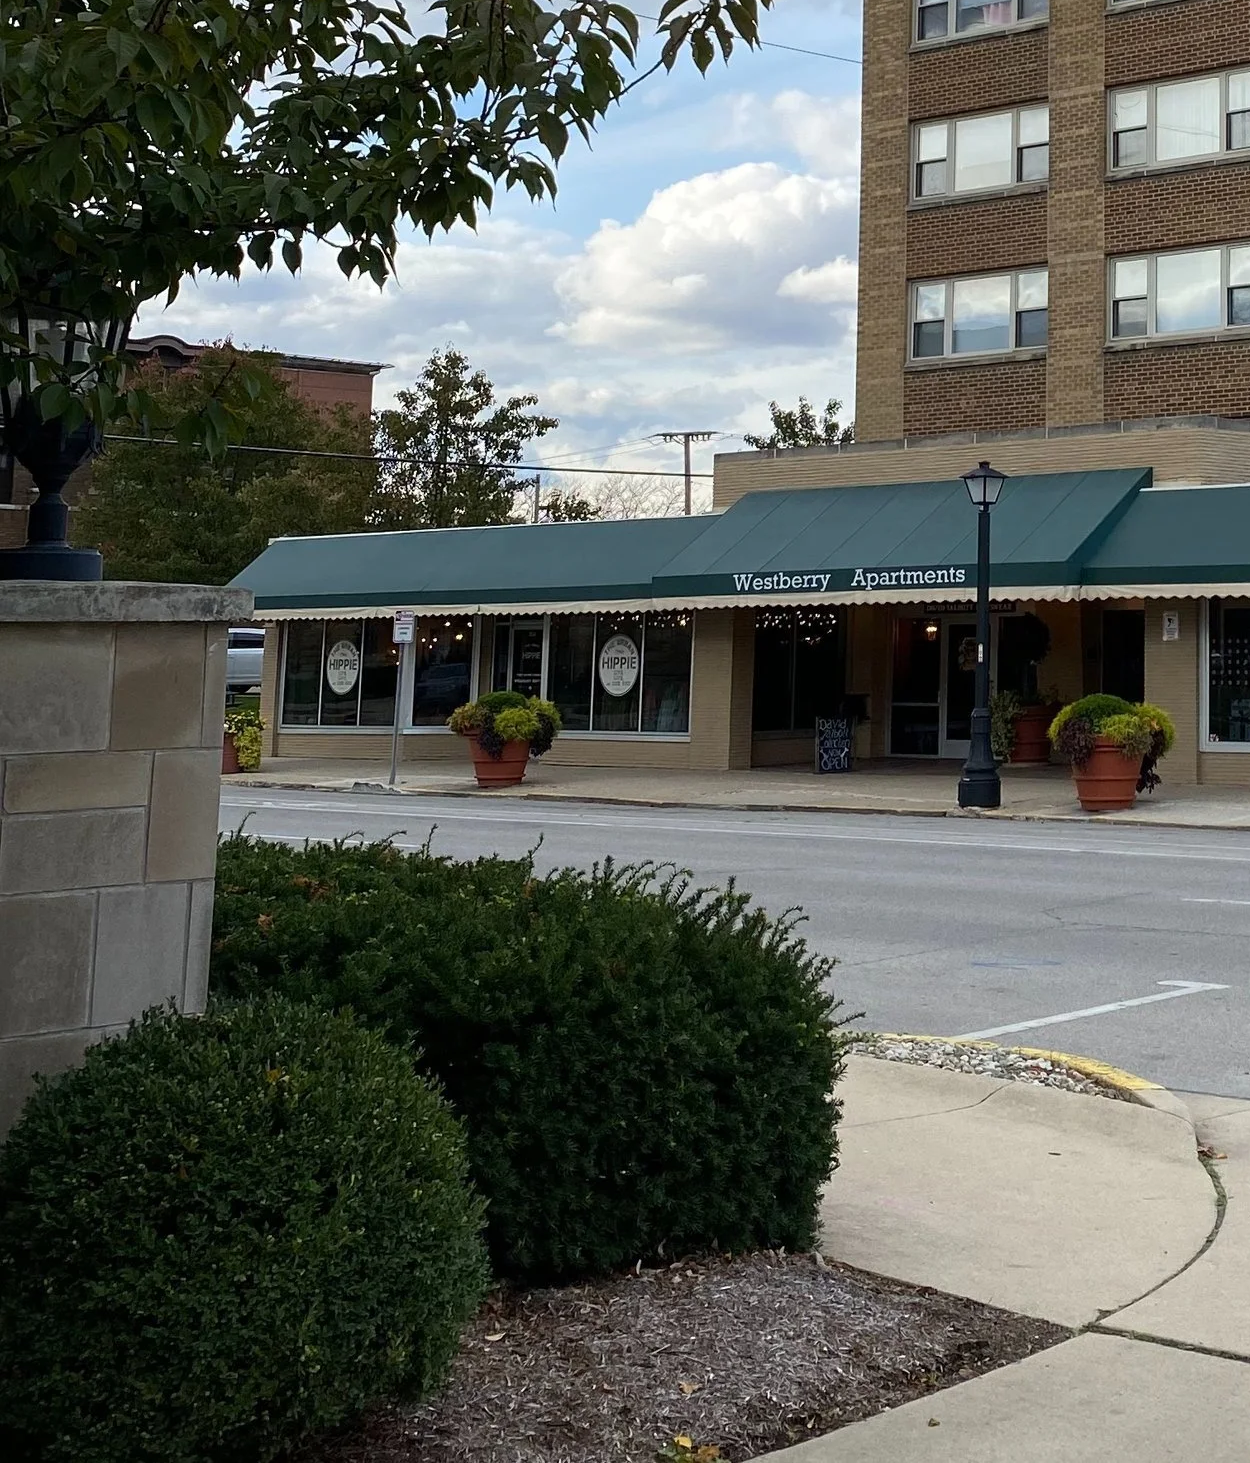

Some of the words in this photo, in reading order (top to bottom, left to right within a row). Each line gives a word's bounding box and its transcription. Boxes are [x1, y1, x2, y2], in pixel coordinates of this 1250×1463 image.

[733, 572, 831, 591] Westberry
[851, 566, 966, 590] Apartments
[329, 659, 357, 670] HIPPIE
[602, 657, 637, 670] HIPPIE
[820, 719, 847, 730] David
[821, 757, 848, 770] OPEN
